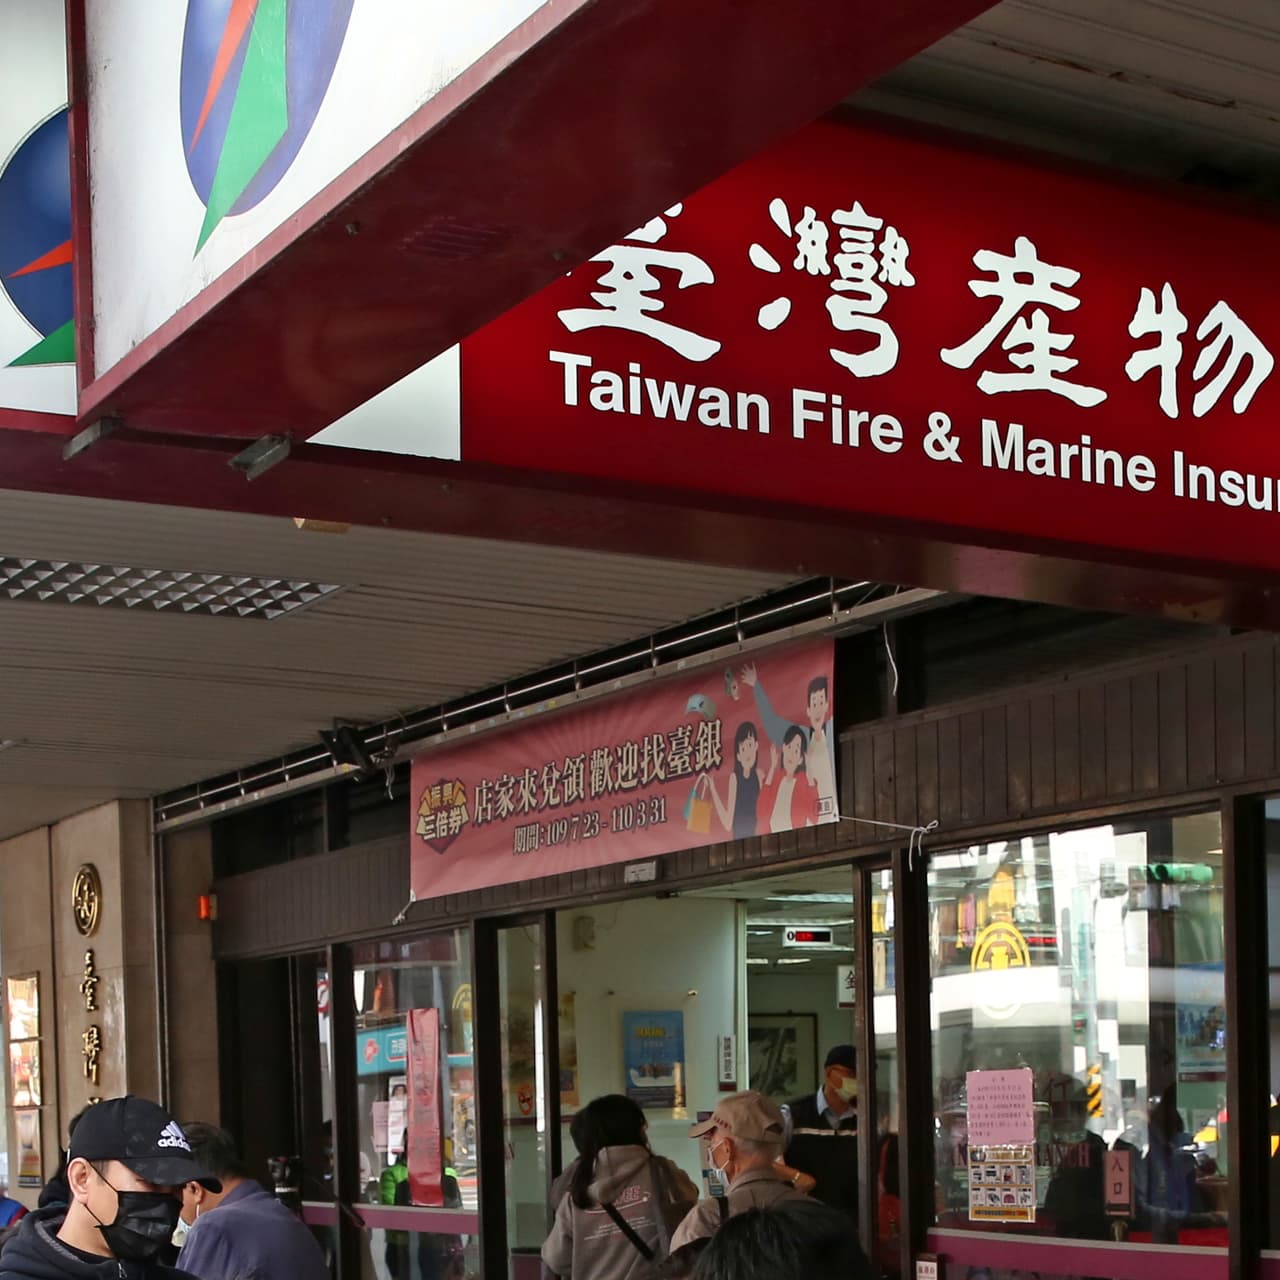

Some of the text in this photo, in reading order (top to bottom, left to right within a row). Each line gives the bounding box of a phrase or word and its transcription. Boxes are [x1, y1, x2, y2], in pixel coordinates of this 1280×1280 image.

[548, 350, 771, 434] Taiwan
[791, 387, 904, 454] Fire
[922, 411, 963, 464] &
[981, 418, 1157, 492] Marine
[423, 806, 462, 841] 三倍券
[473, 718, 723, 824] 店家來兌領 歡迎找臺銀
